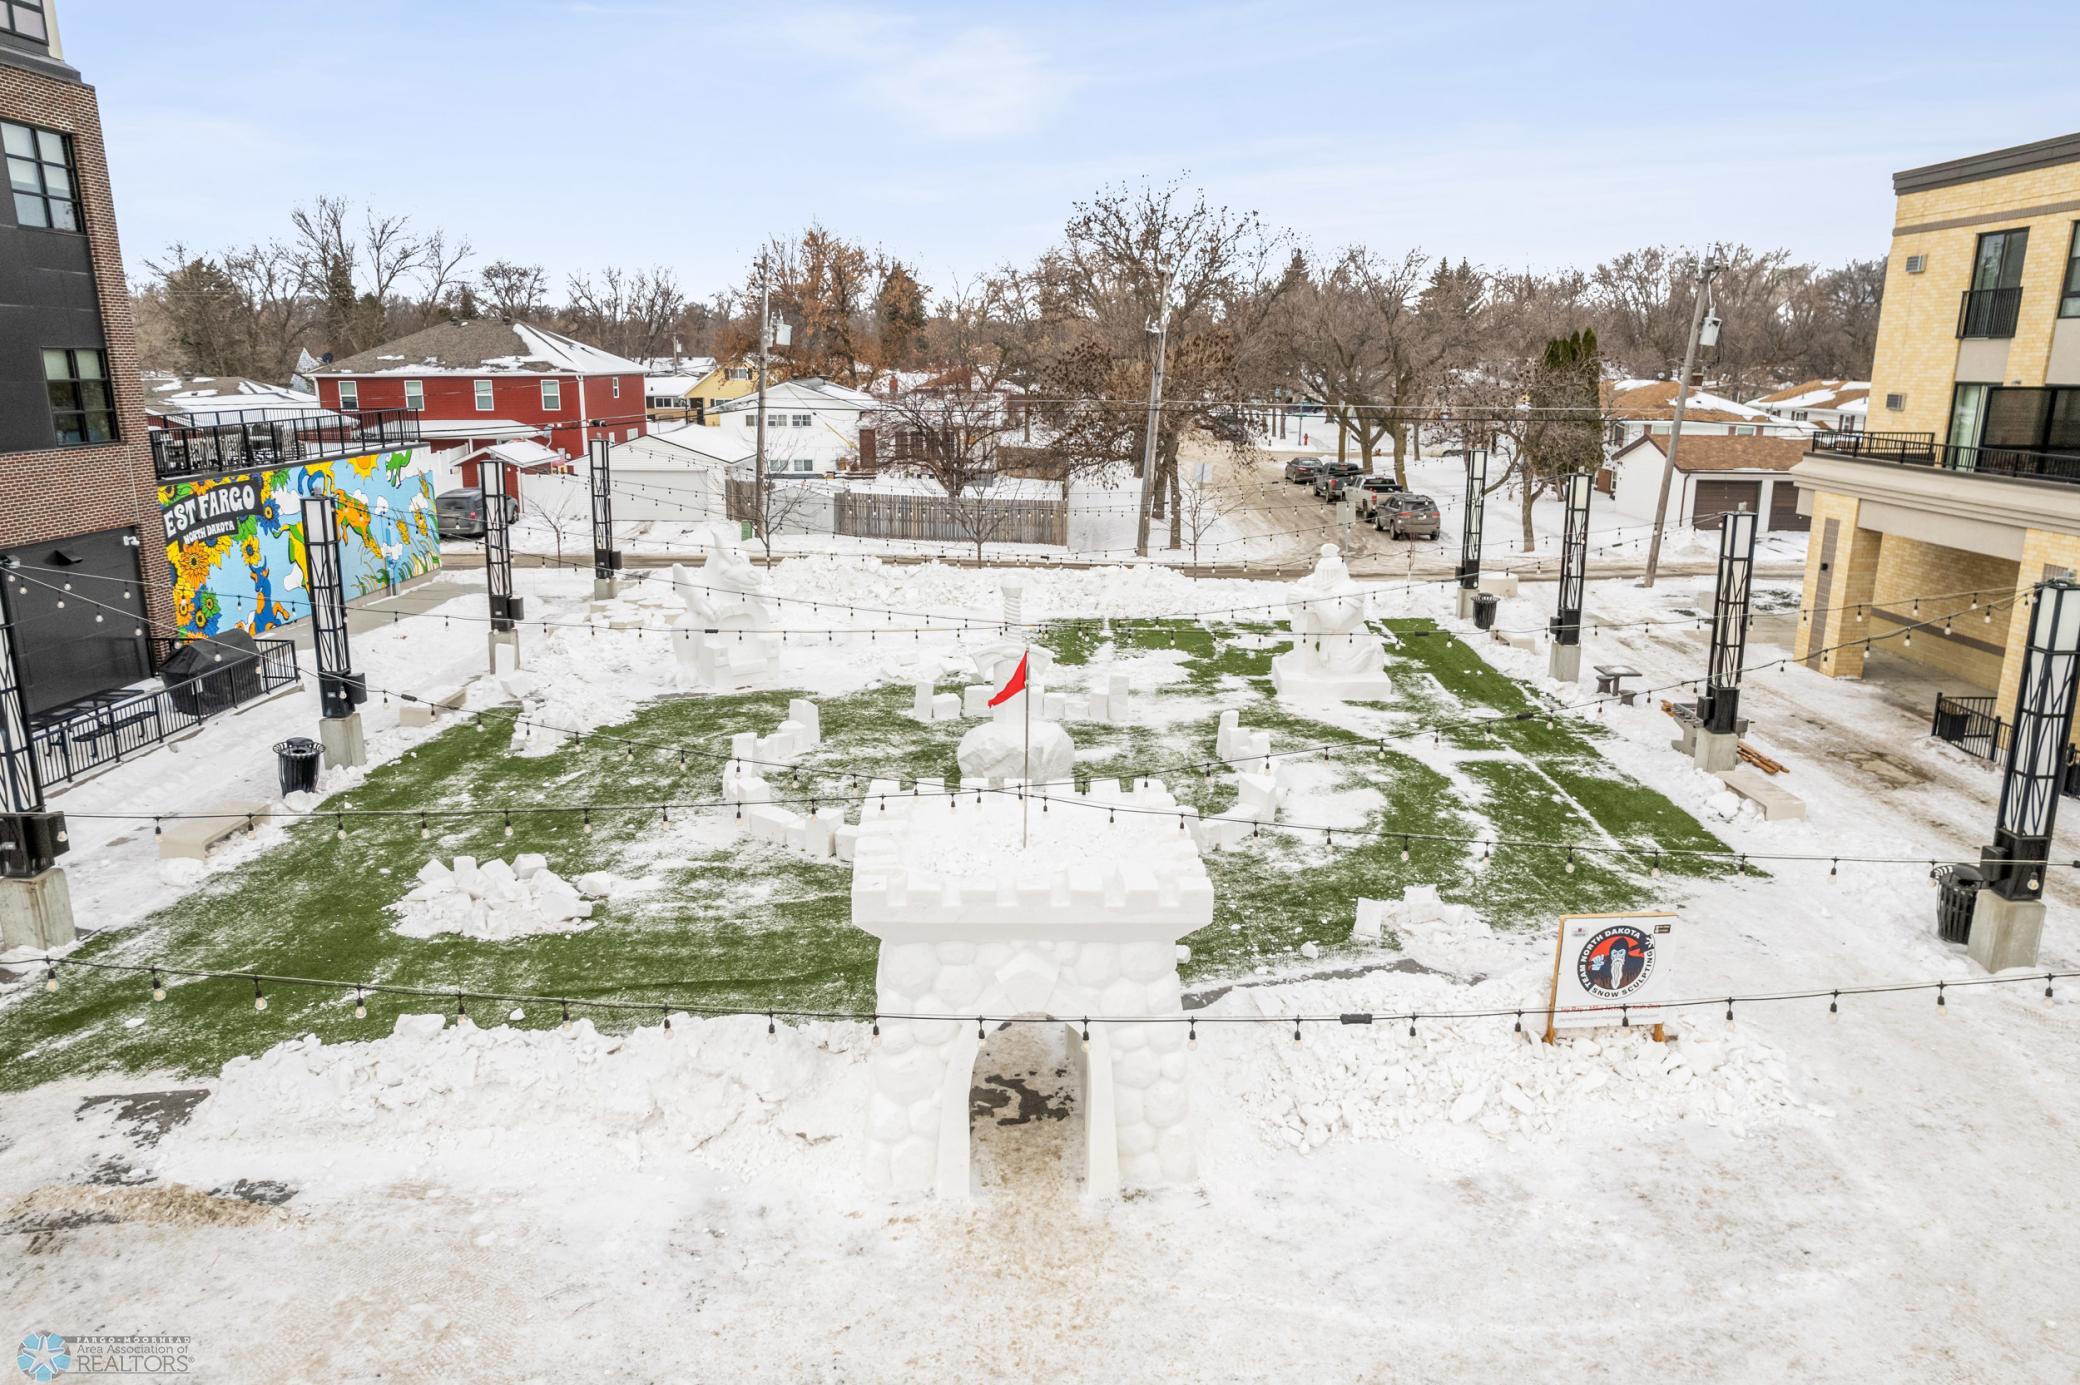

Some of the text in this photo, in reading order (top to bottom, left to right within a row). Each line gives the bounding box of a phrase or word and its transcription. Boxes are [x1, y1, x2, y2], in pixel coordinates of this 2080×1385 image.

[198, 484, 256, 519] FARGO
[183, 520, 235, 544] NORTH DAKOTA
[1604, 927, 1641, 939] DAKOTA
[1580, 934, 1604, 963] NORTH
[1579, 964, 1592, 988] TEAM
[1591, 950, 1653, 998] SNOW SCULPTING
